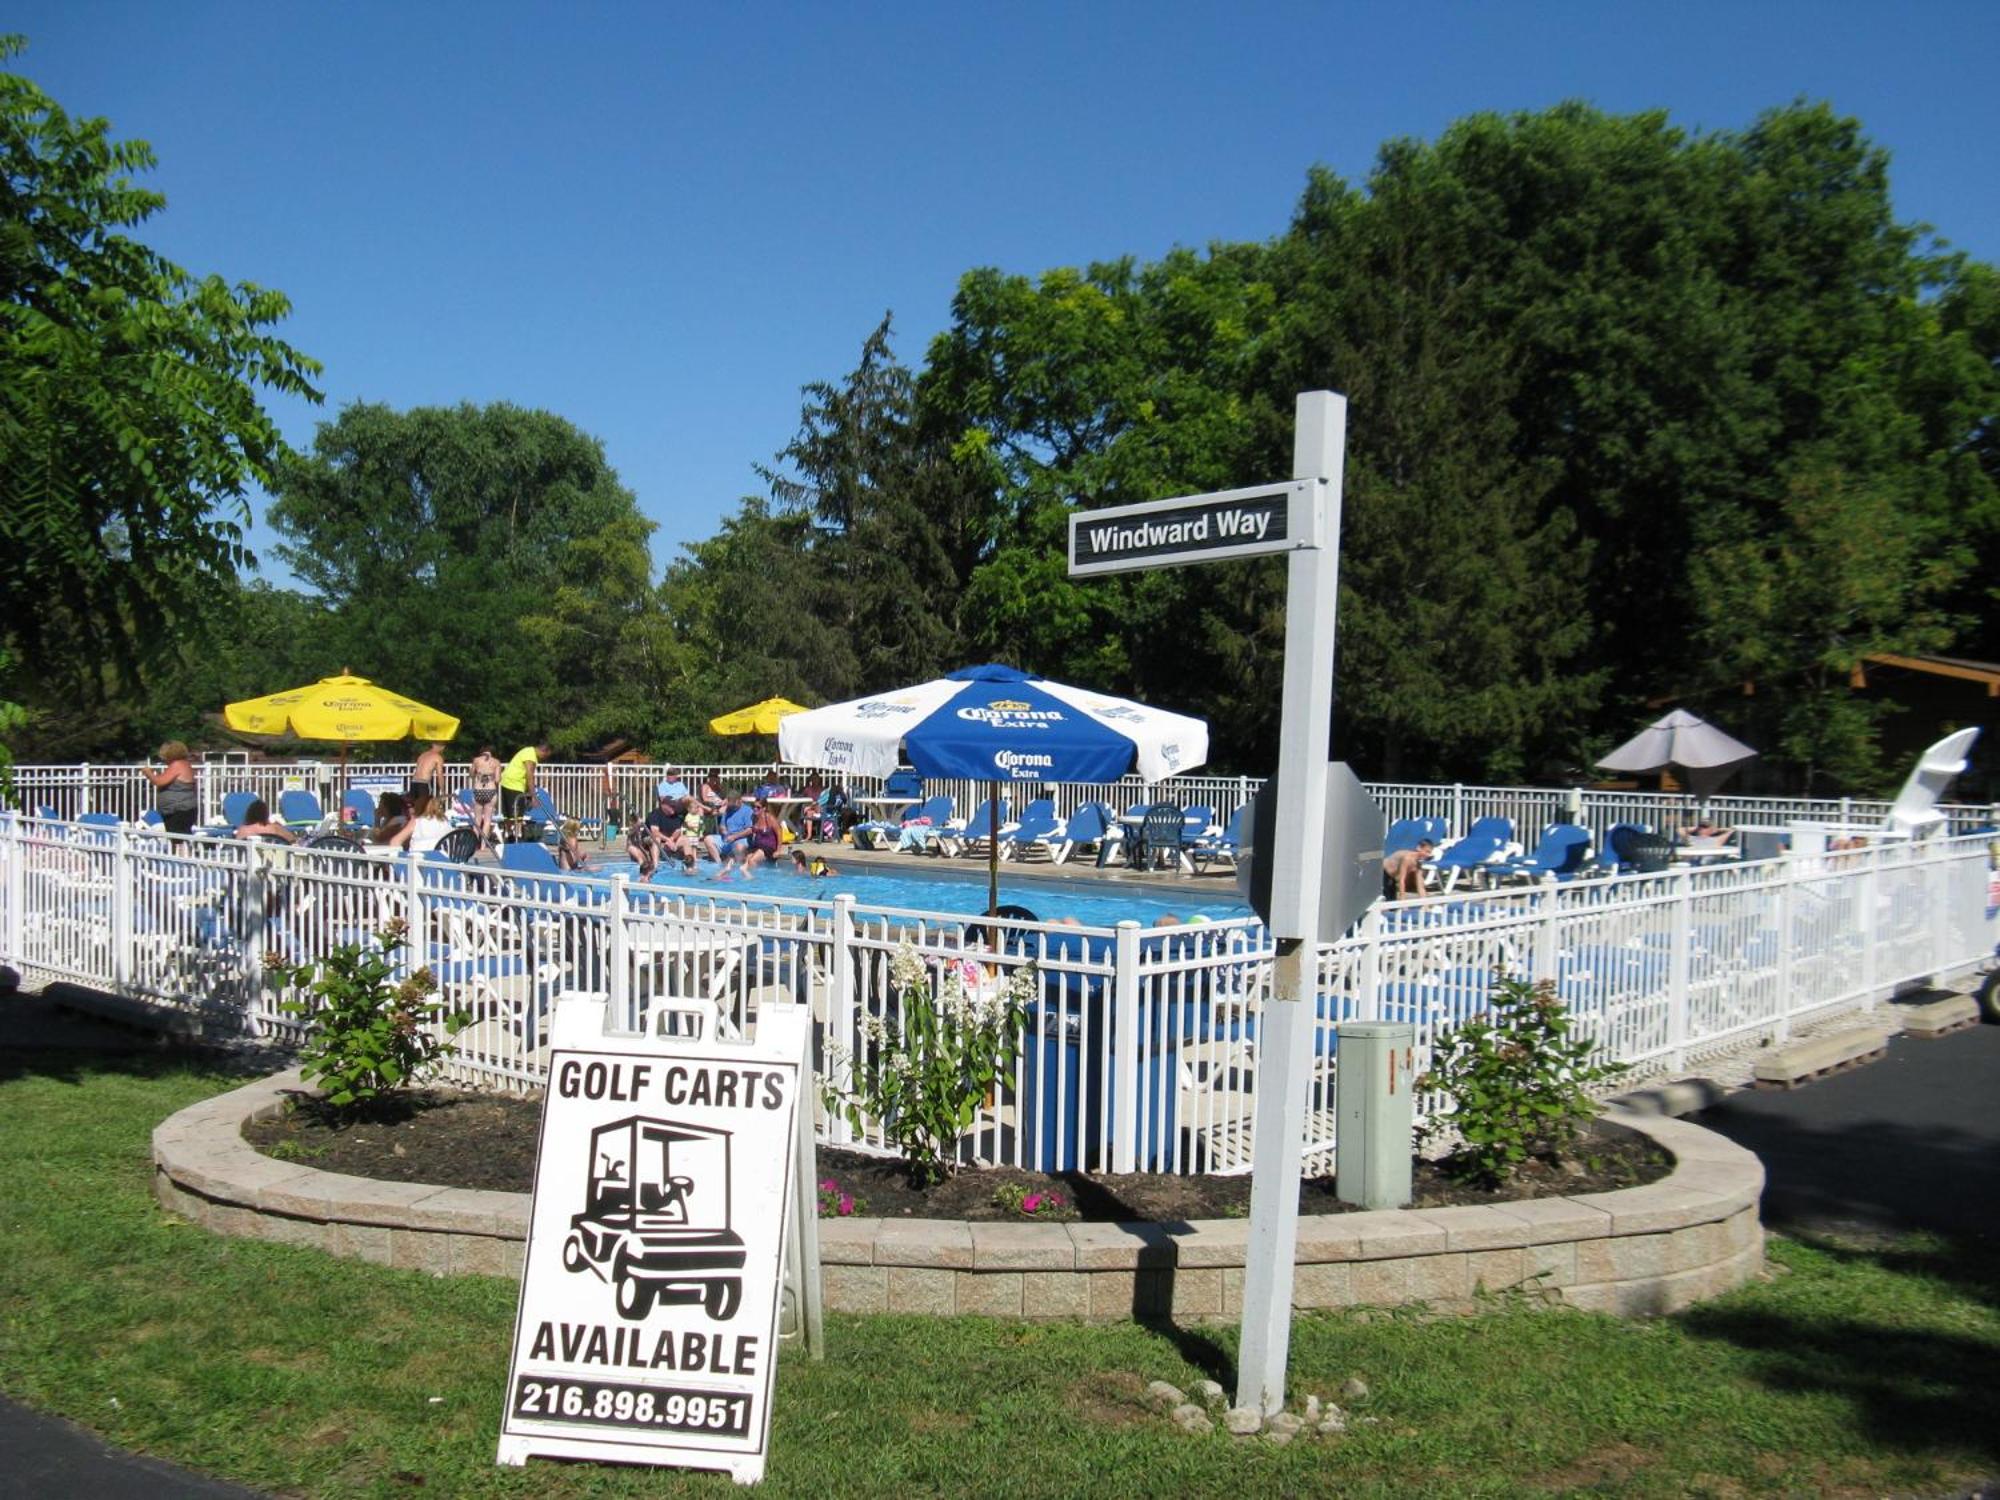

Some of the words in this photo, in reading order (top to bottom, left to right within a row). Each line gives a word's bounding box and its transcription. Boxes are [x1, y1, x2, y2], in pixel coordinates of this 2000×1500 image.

[1090, 515, 1208, 553] Windward
[1216, 509, 1270, 539] Way
[957, 707, 1064, 720] Corona
[991, 719, 1049, 728] Extra
[995, 750, 1053, 769] Corona
[1011, 767, 1040, 778] Extra
[559, 1060, 652, 1101] GOLF
[664, 1066, 785, 1110] CARTS
[529, 1321, 759, 1376] AVAILABLE
[520, 1383, 747, 1430] 216.898.9951
